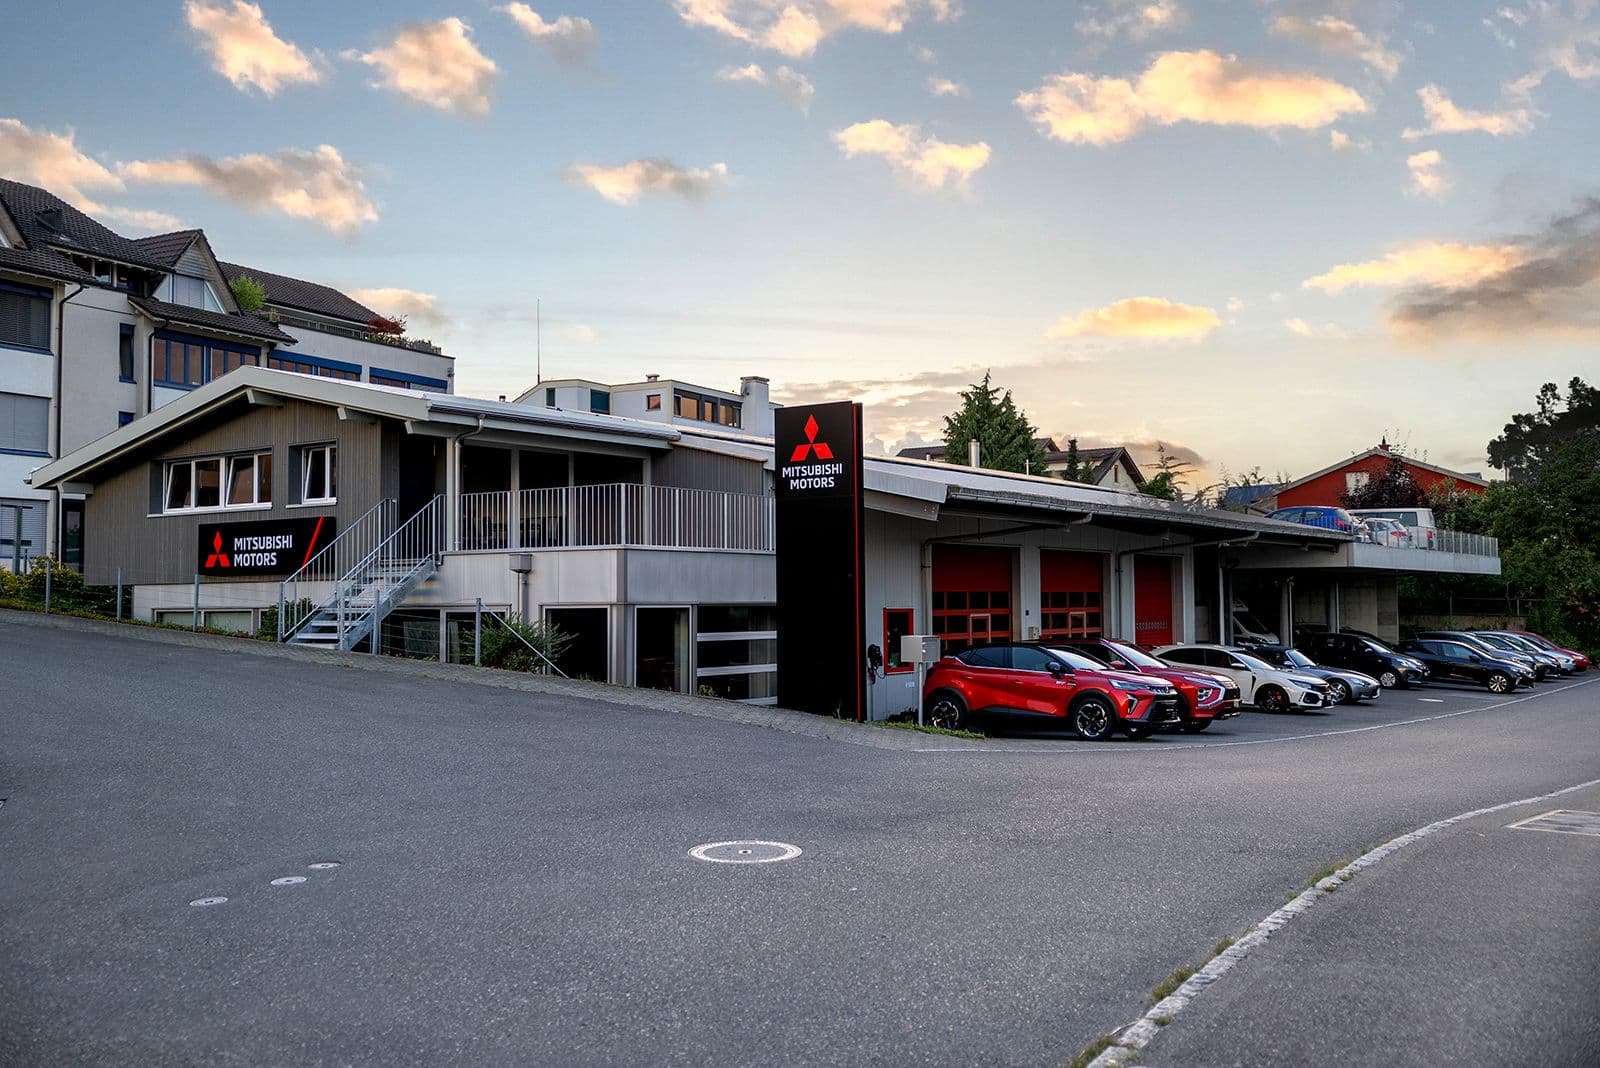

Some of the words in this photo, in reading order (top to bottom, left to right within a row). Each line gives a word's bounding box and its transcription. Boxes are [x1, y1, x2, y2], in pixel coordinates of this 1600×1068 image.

[782, 463, 842, 478] MITSUBISHI
[790, 477, 835, 490] MOTORS
[233, 534, 293, 551] MITSUBISHI
[233, 552, 277, 567] MOTORS
